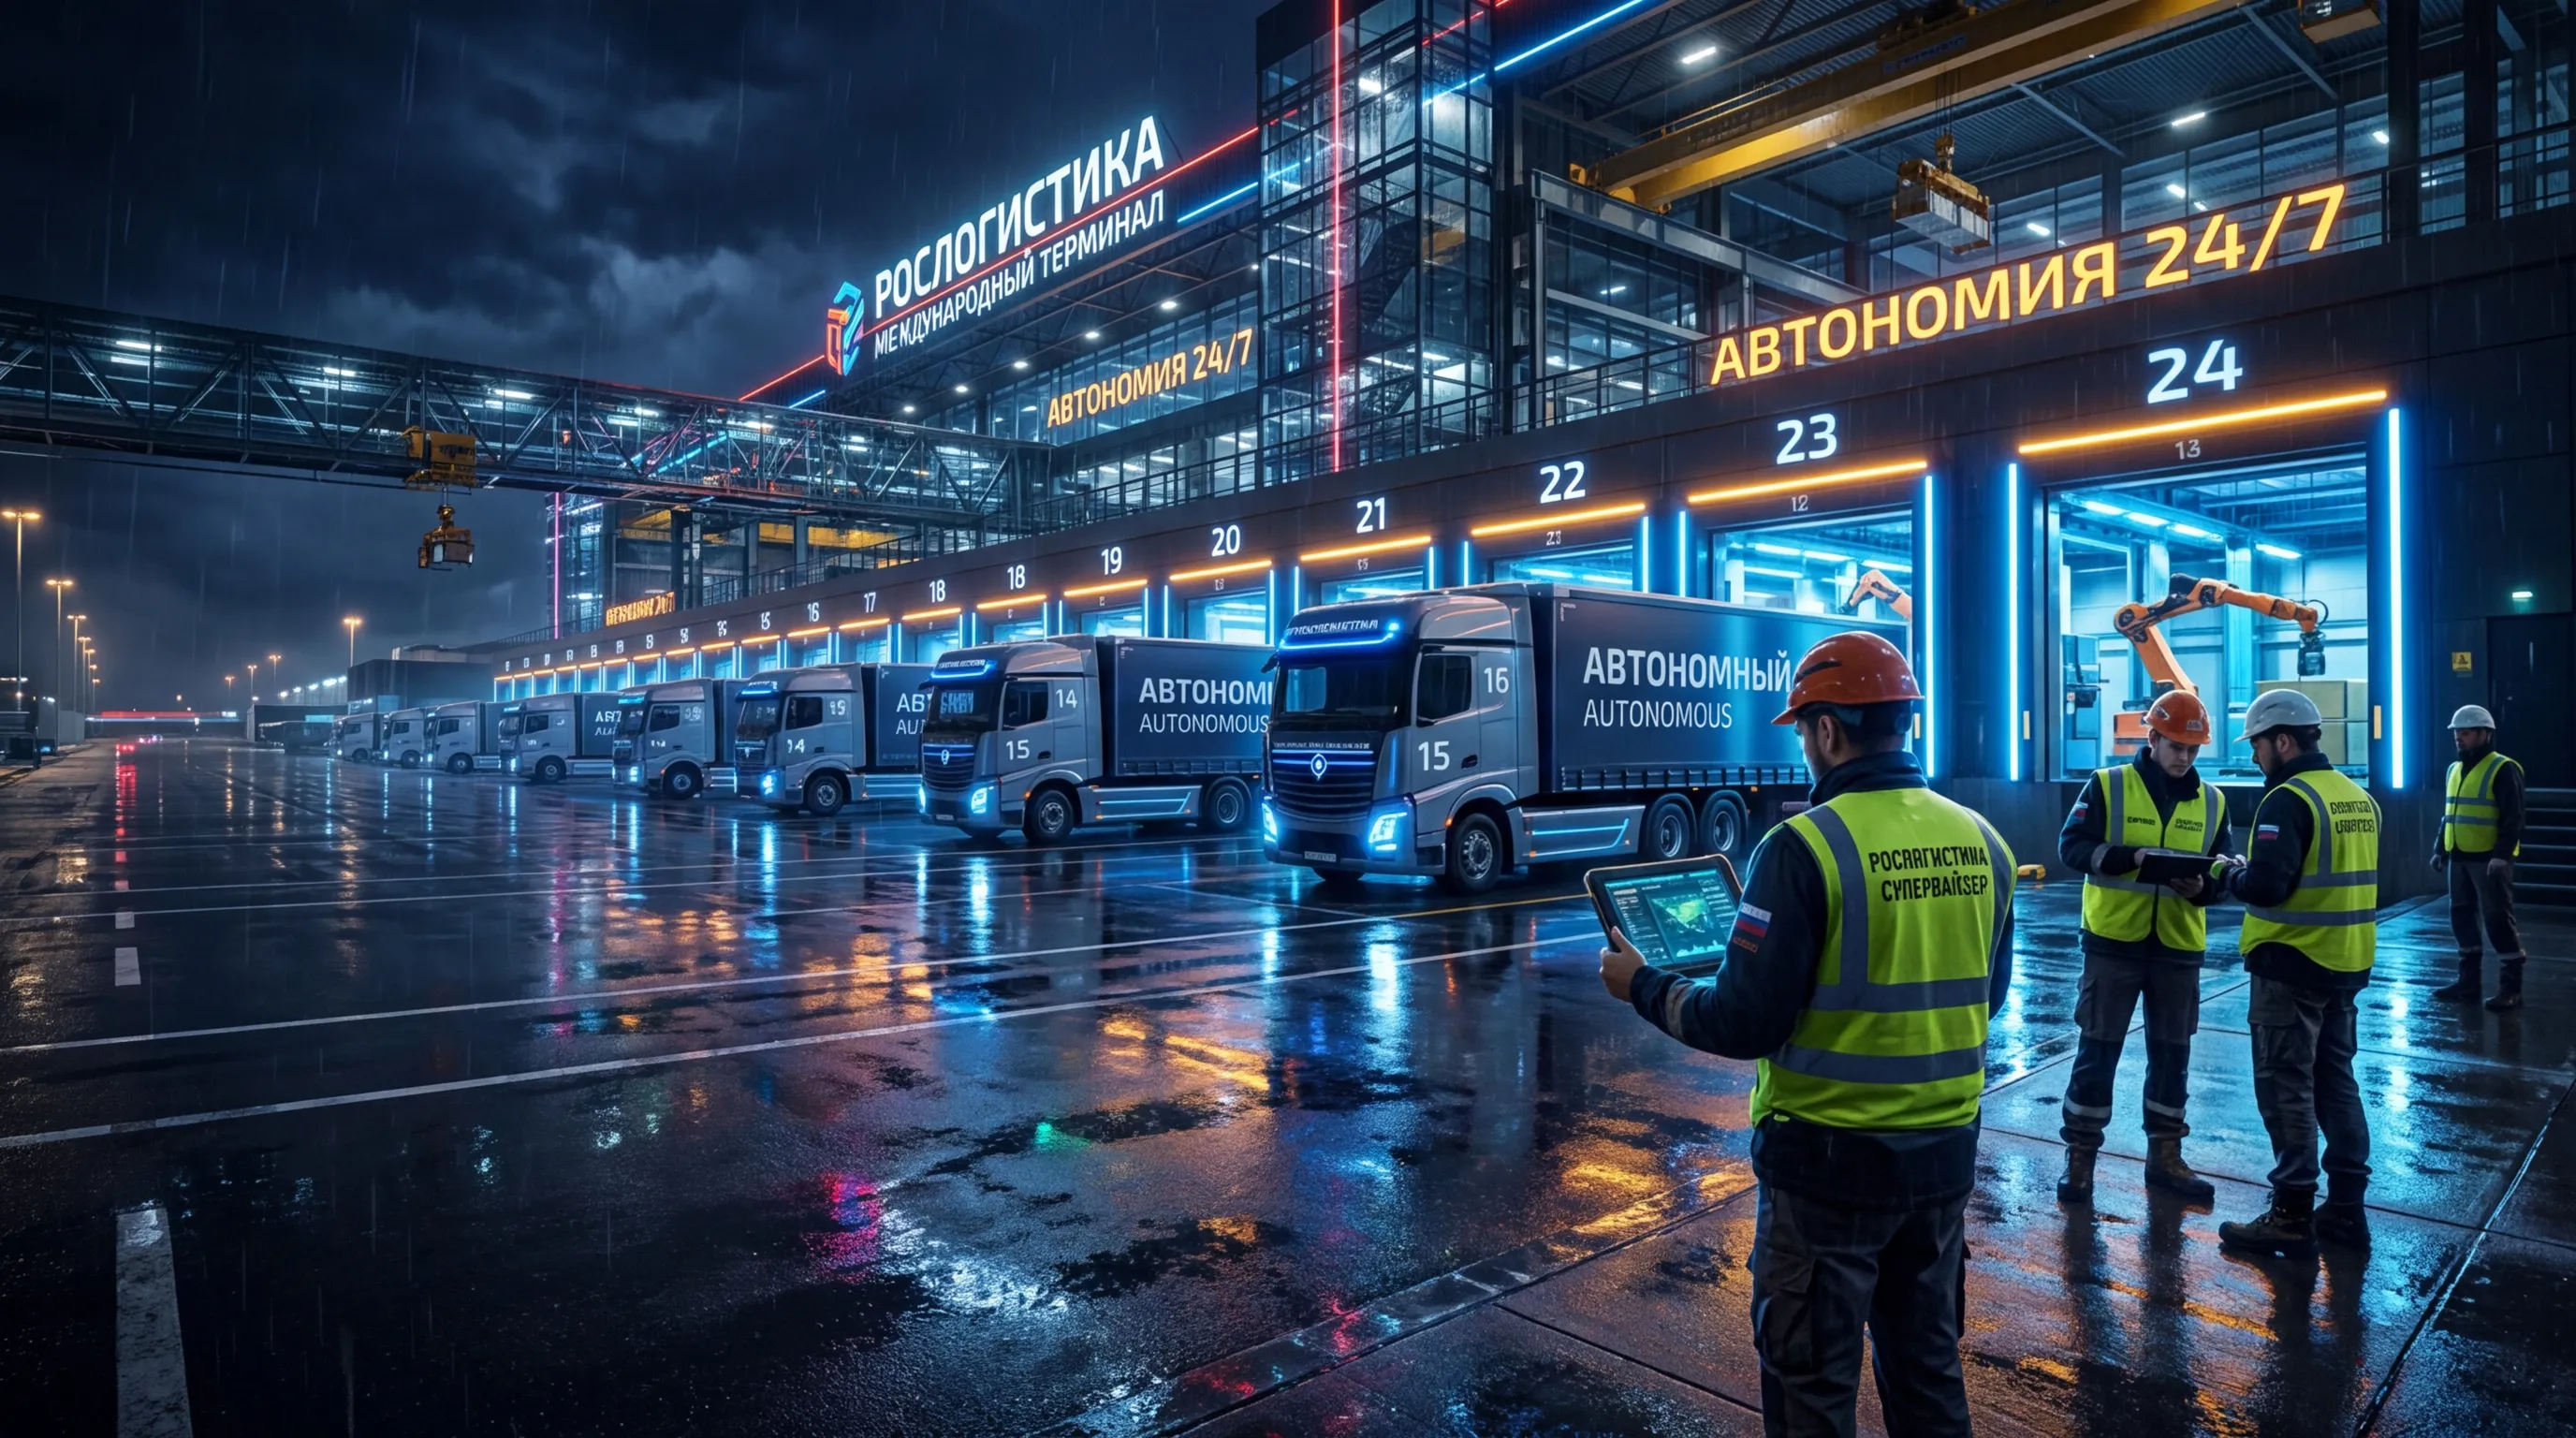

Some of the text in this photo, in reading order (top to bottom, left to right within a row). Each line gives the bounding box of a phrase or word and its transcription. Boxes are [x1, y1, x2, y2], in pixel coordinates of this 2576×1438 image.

[874, 115, 1164, 318] РОСЛОГИСТИКА
[1040, 190, 1164, 275] ТЕРМИНАЛ
[1711, 184, 2346, 385] АВТОНОМИЯ 24/7
[1046, 328, 1252, 429] АВТОНОМИЯ 24/7
[2146, 339, 2244, 404] 24
[1777, 413, 1838, 464] 23
[2174, 439, 2202, 460] 13
[1539, 461, 1587, 505] 22
[1355, 497, 1385, 534] 21
[1211, 524, 1241, 557] 20
[1101, 546, 1122, 576] 19
[929, 579, 946, 603] 18
[1007, 565, 1026, 591] 18
[863, 592, 876, 613] 17
[1484, 667, 1510, 694] 16
[1583, 647, 1792, 693] АВТОНОМНЫЙ
[896, 693, 932, 712] АВ
[1055, 688, 1077, 710] 14
[1583, 698, 1733, 729] AUTONOMOUS
[1139, 712, 1269, 734] AUTONOMOUS
[1006, 740, 1030, 761] 15
[1417, 740, 1451, 771] 15
